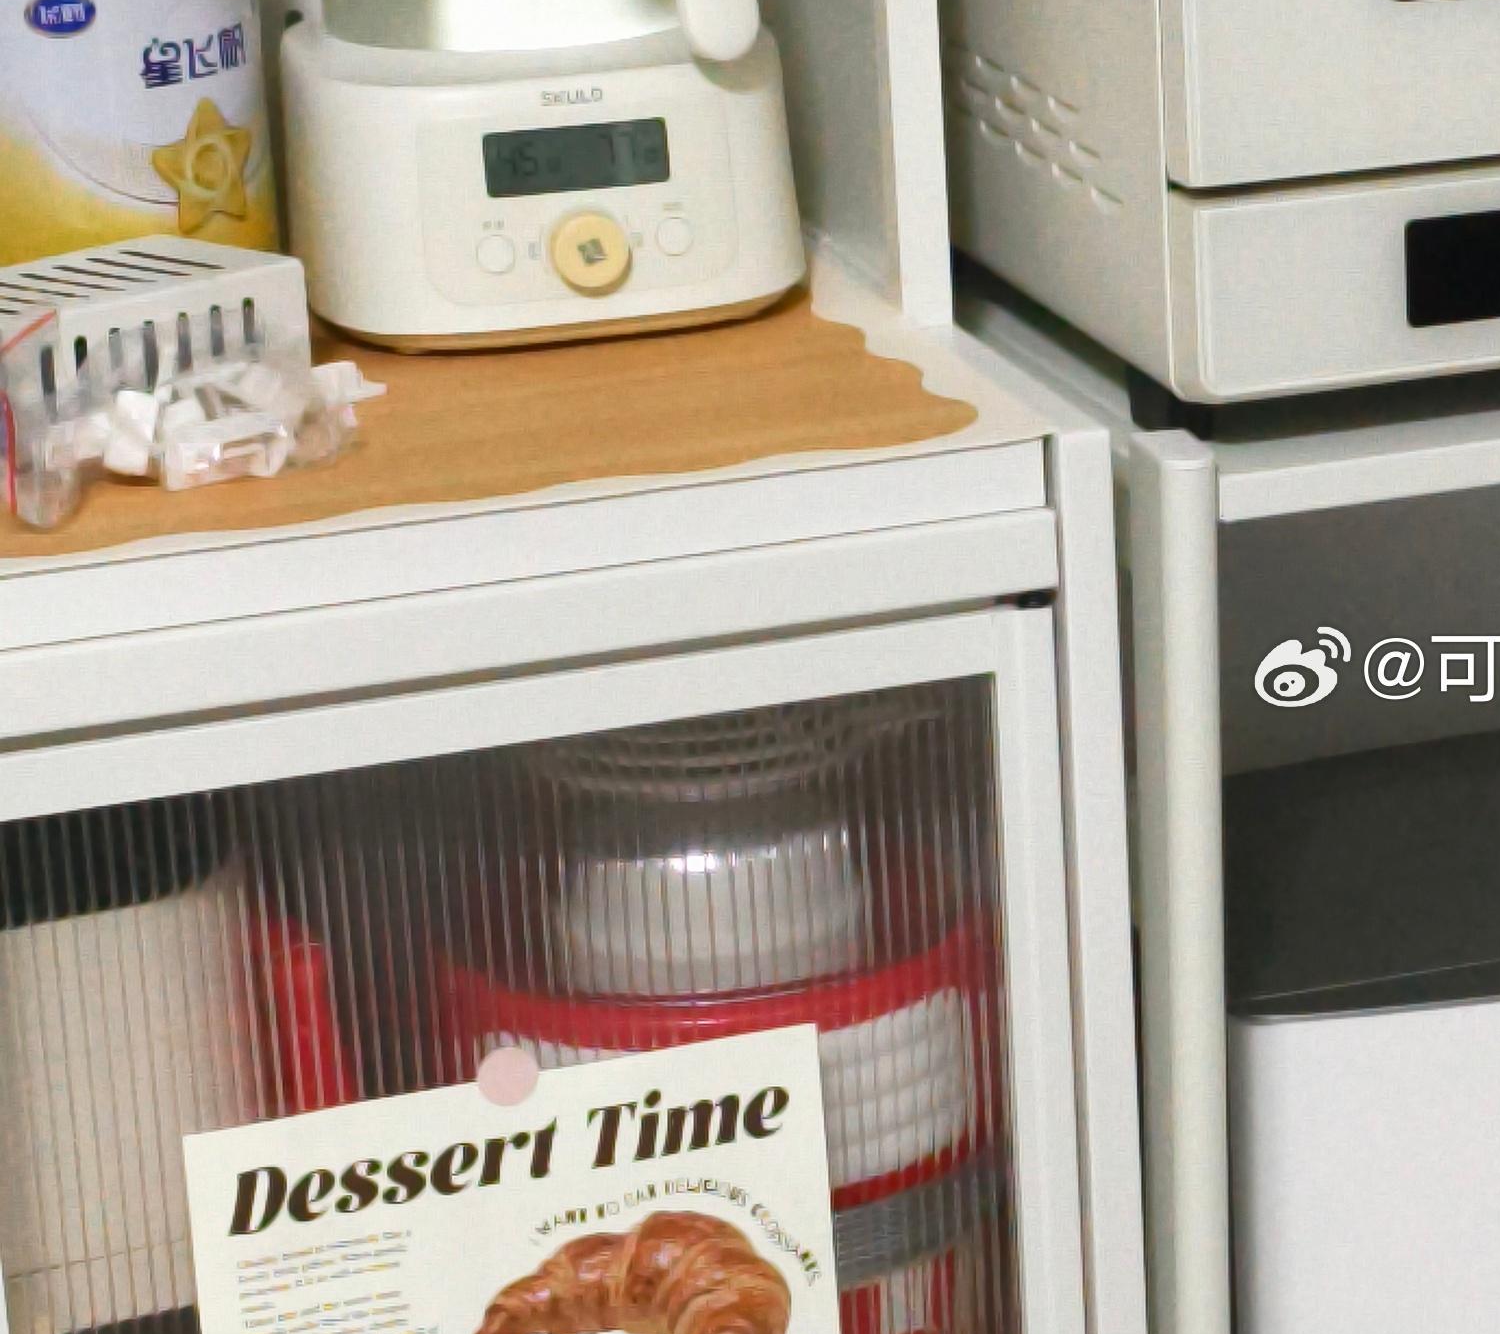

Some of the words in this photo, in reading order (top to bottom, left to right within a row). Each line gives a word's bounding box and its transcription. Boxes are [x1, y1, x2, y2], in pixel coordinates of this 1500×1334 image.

[140, 22, 247, 89] 星飞帆
[226, 1115, 558, 1236] Dessert
[586, 1084, 790, 1170] Time
